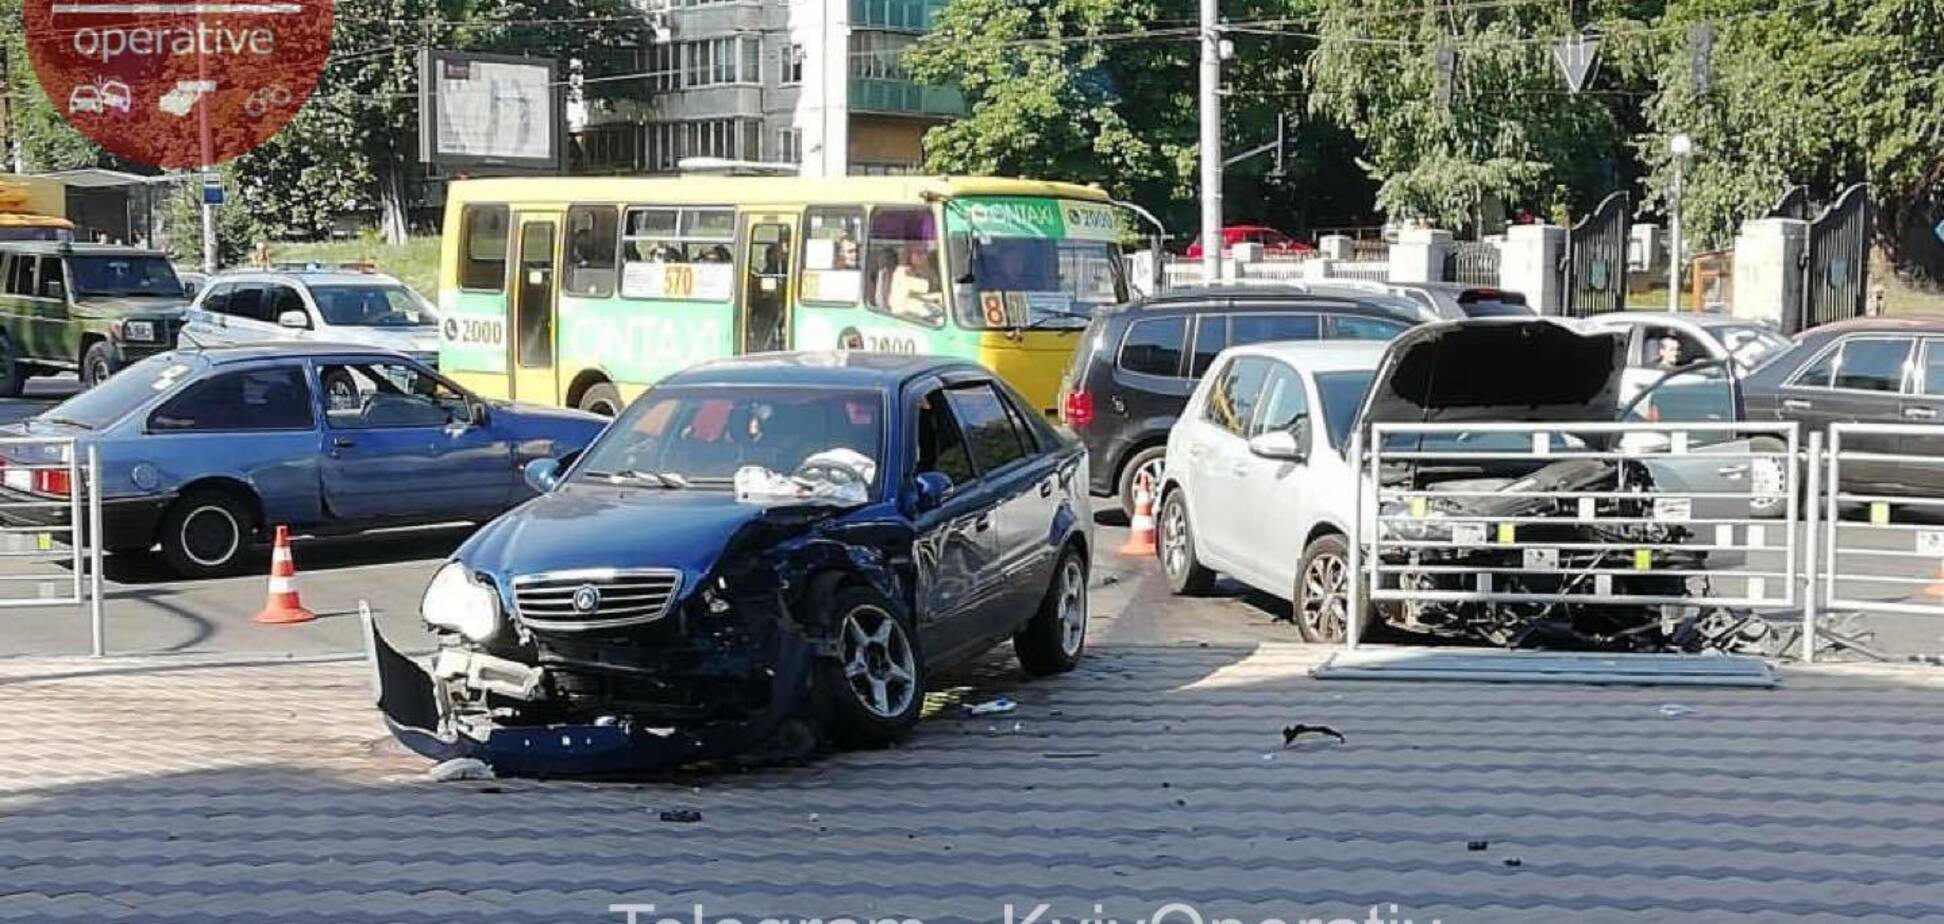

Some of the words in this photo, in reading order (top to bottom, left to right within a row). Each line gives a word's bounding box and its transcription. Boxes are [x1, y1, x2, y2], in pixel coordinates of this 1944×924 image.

[665, 266, 692, 295] 570
[985, 296, 1003, 323] 8
[463, 319, 502, 343] 2000
